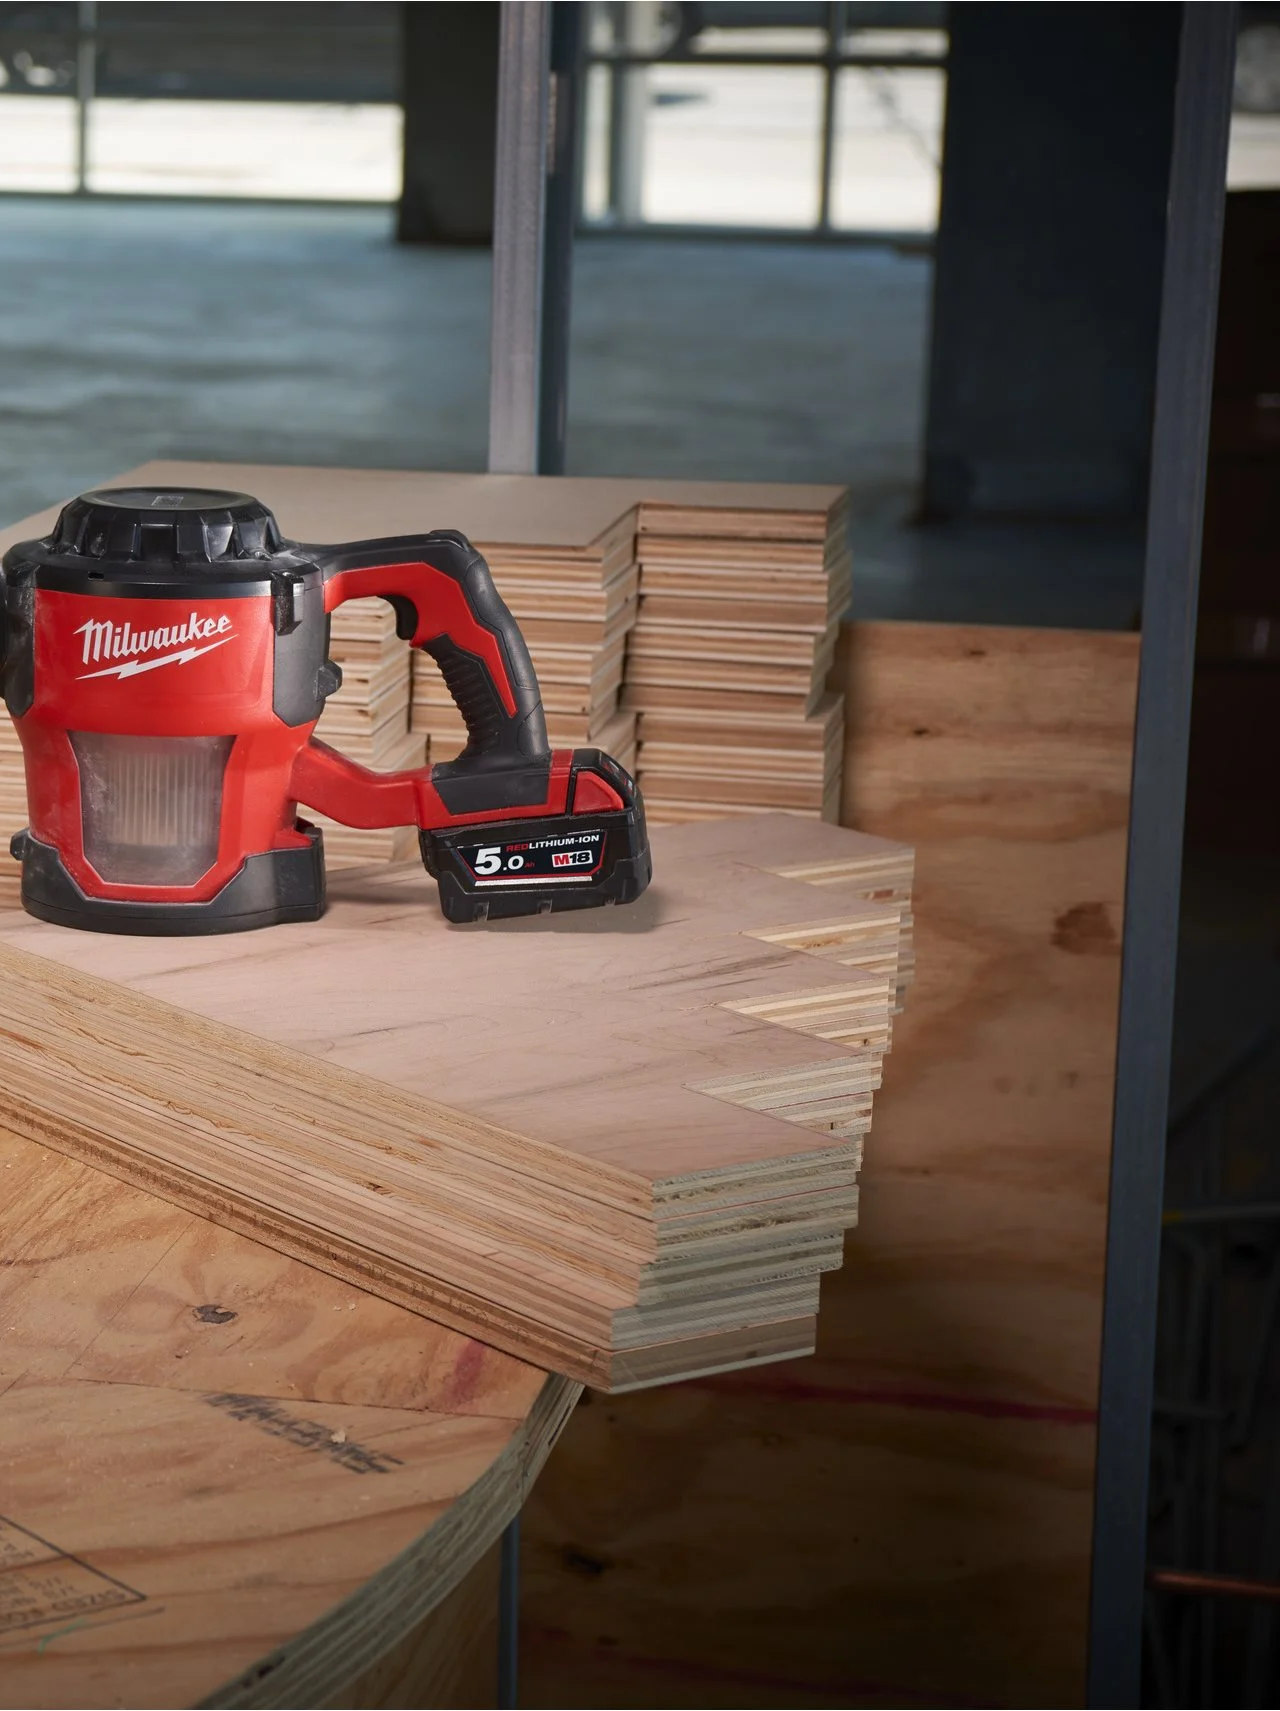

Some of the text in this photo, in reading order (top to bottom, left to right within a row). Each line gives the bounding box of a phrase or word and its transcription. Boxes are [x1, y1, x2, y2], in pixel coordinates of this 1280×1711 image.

[73, 612, 233, 665] Milwaukee
[505, 834, 600, 852] REDLITHIUM-ION
[473, 846, 524, 875] 5.0
[554, 852, 590, 867] M18
